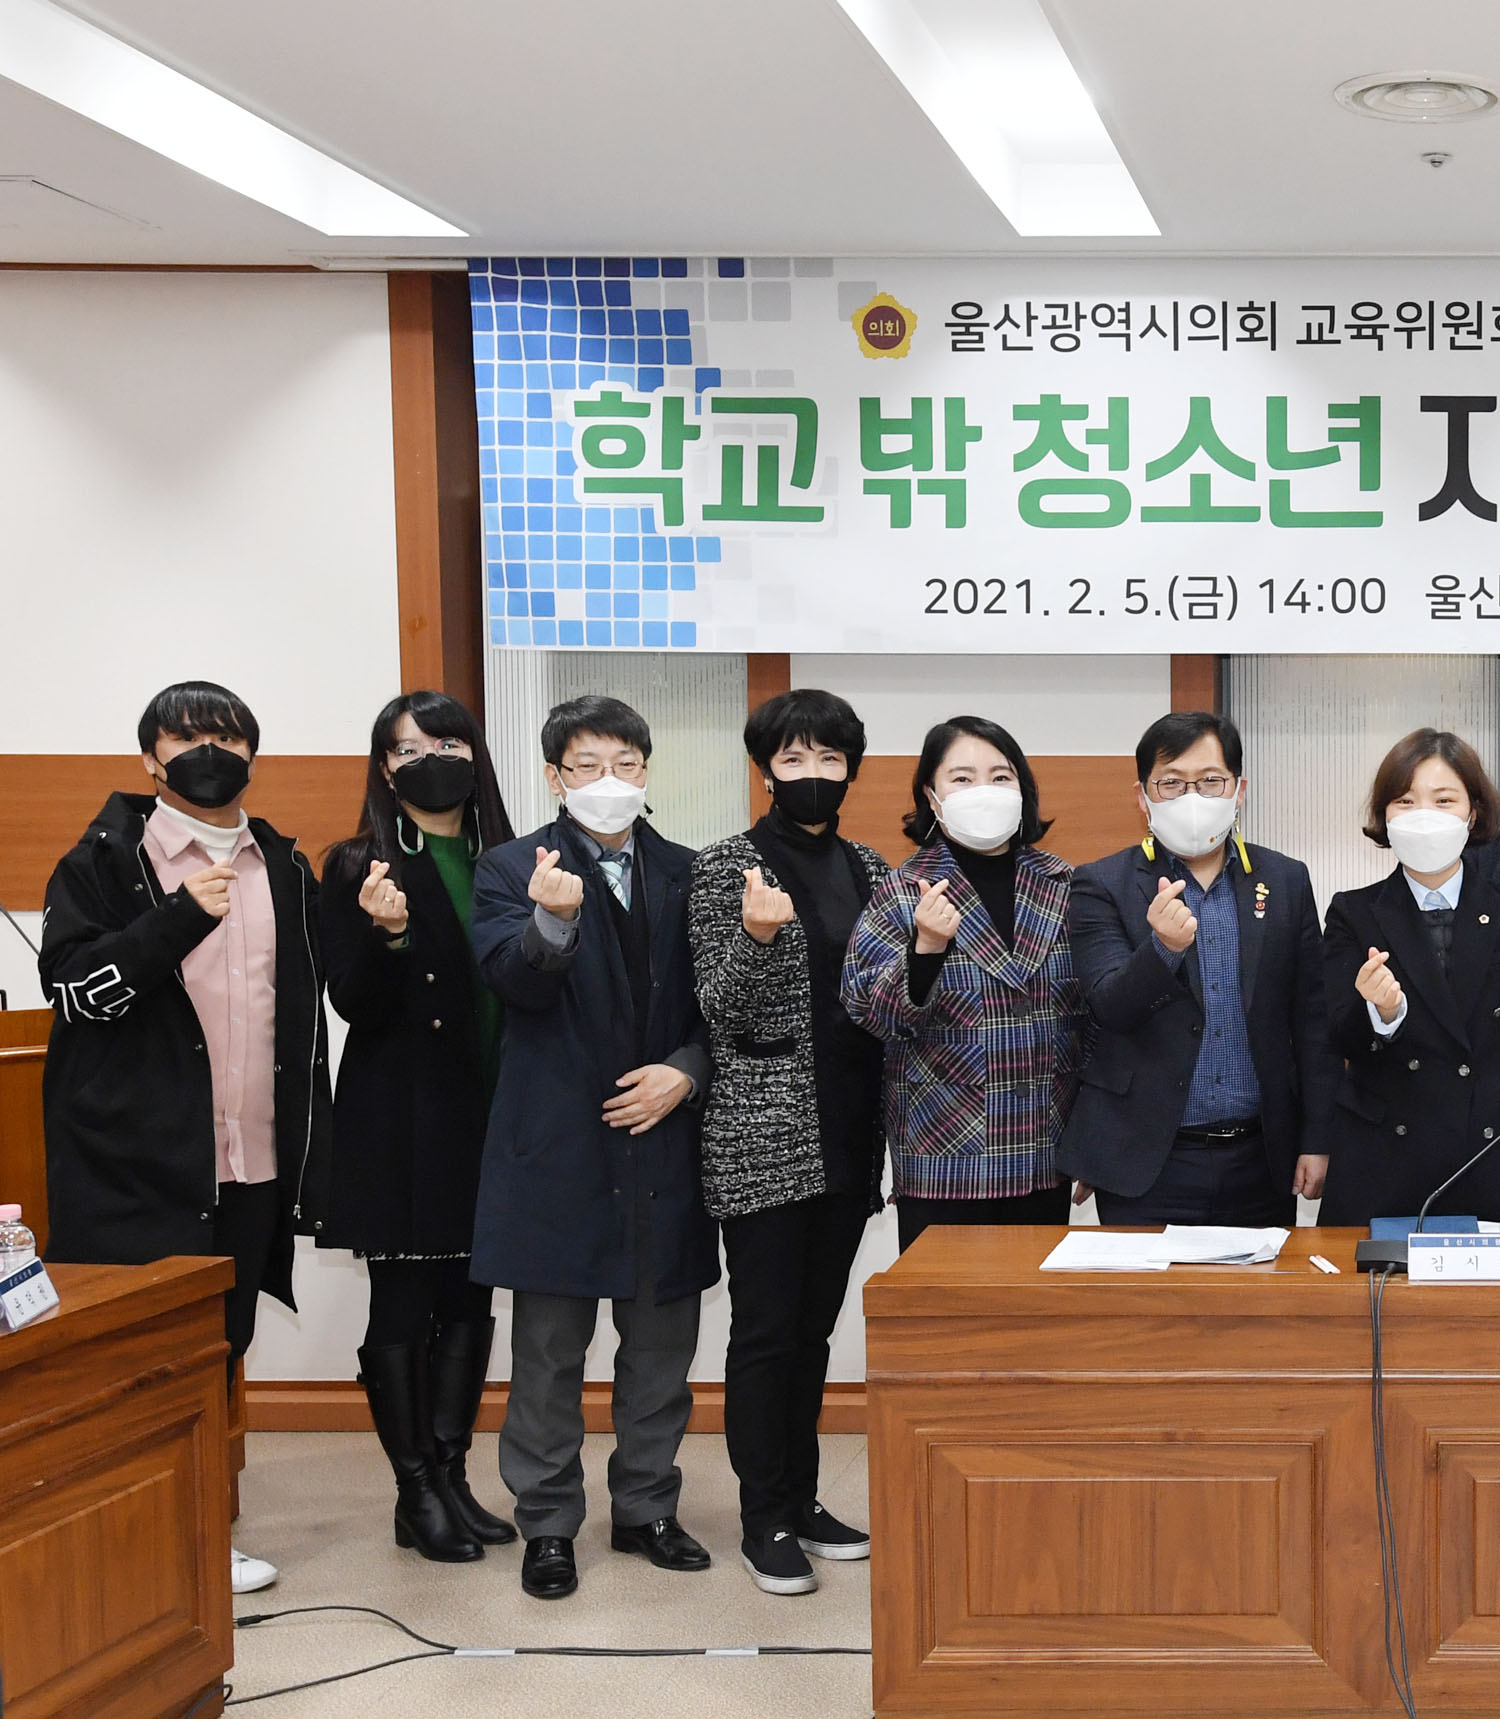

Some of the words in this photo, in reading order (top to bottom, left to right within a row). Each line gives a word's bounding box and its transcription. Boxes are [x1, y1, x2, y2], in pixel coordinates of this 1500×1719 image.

[867, 319, 899, 337] 의회
[944, 301, 1277, 352] 울산광역시의회
[573, 390, 825, 527] 학교
[860, 395, 983, 529] 밖
[1011, 393, 1384, 529] 청소년
[924, 578, 1049, 616] 2021.
[1068, 578, 1105, 616] 2.
[1124, 575, 1238, 621] 5.(금)
[1259, 577, 1386, 615] 14:00
